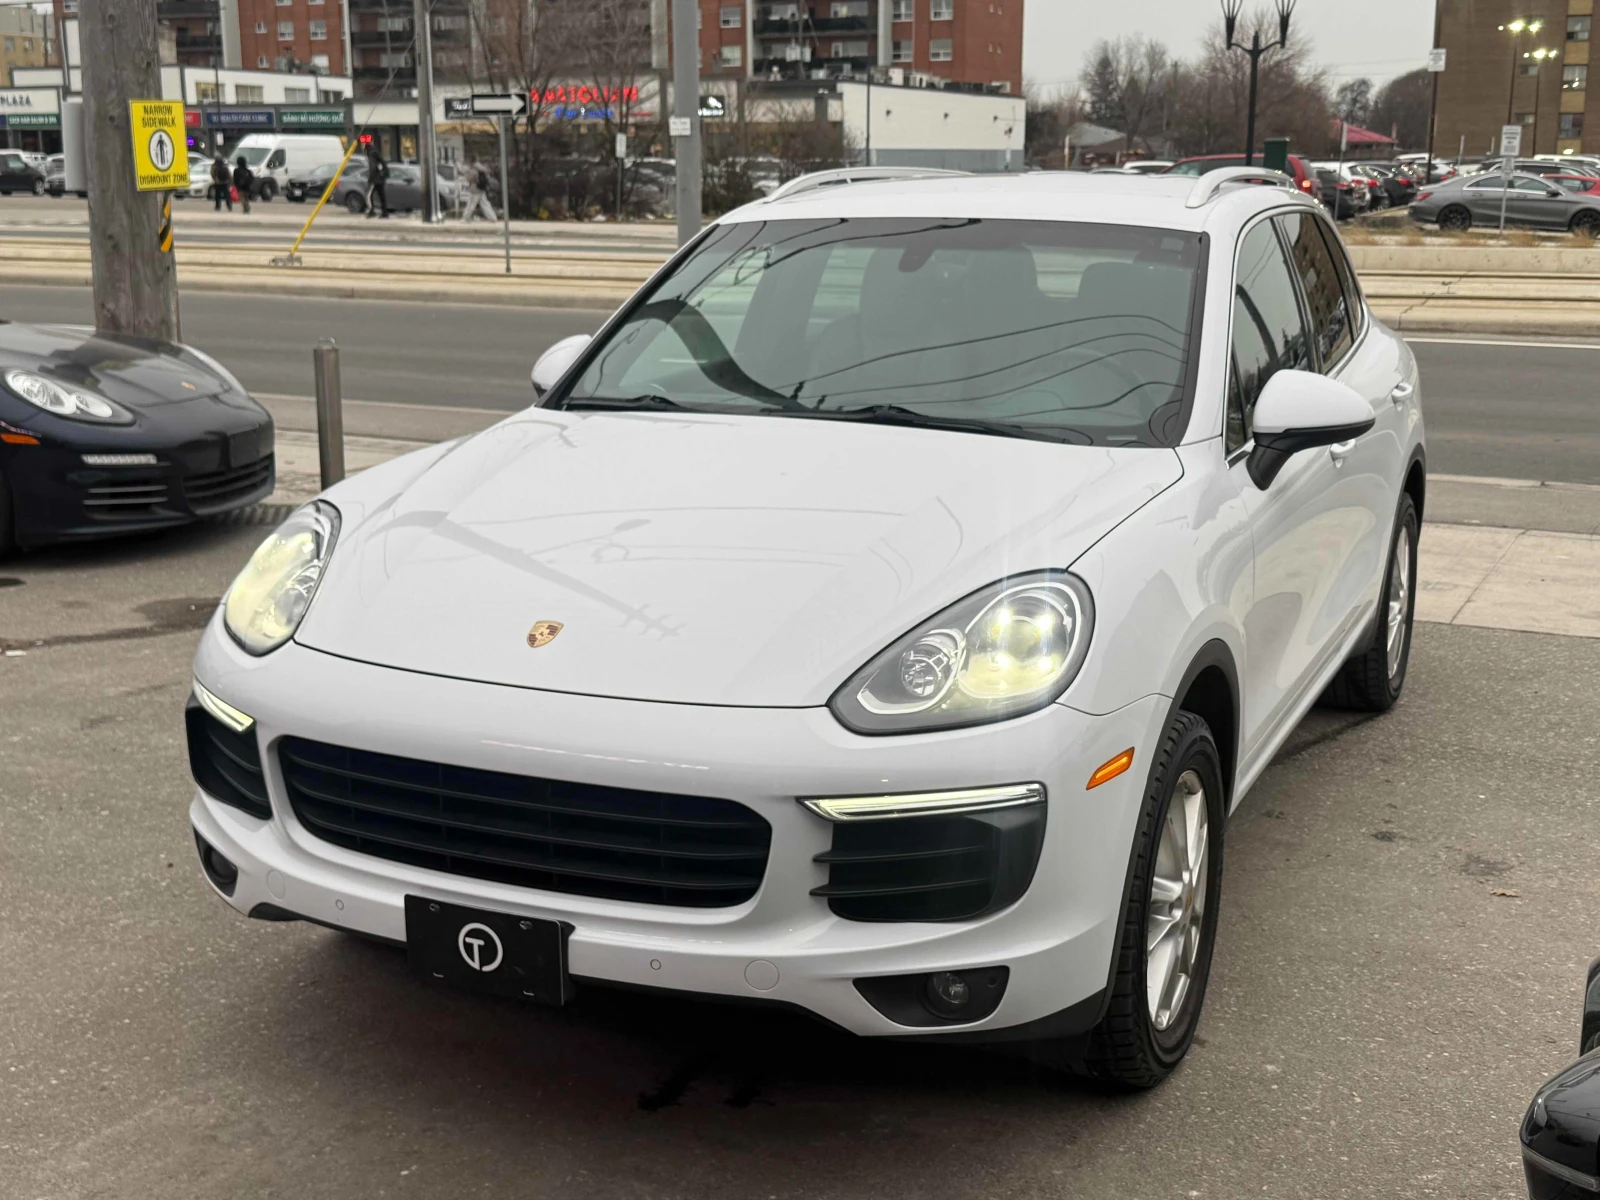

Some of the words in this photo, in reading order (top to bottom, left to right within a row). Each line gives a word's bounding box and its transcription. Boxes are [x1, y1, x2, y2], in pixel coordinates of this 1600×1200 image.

[0, 95, 32, 106] PLAZA
[530, 86, 638, 104] ANATOLIAN
[143, 105, 173, 115] NARROW
[142, 117, 176, 128] SIDEWALK
[139, 175, 171, 186] DISMOUNT
[172, 173, 188, 184] ZONE
